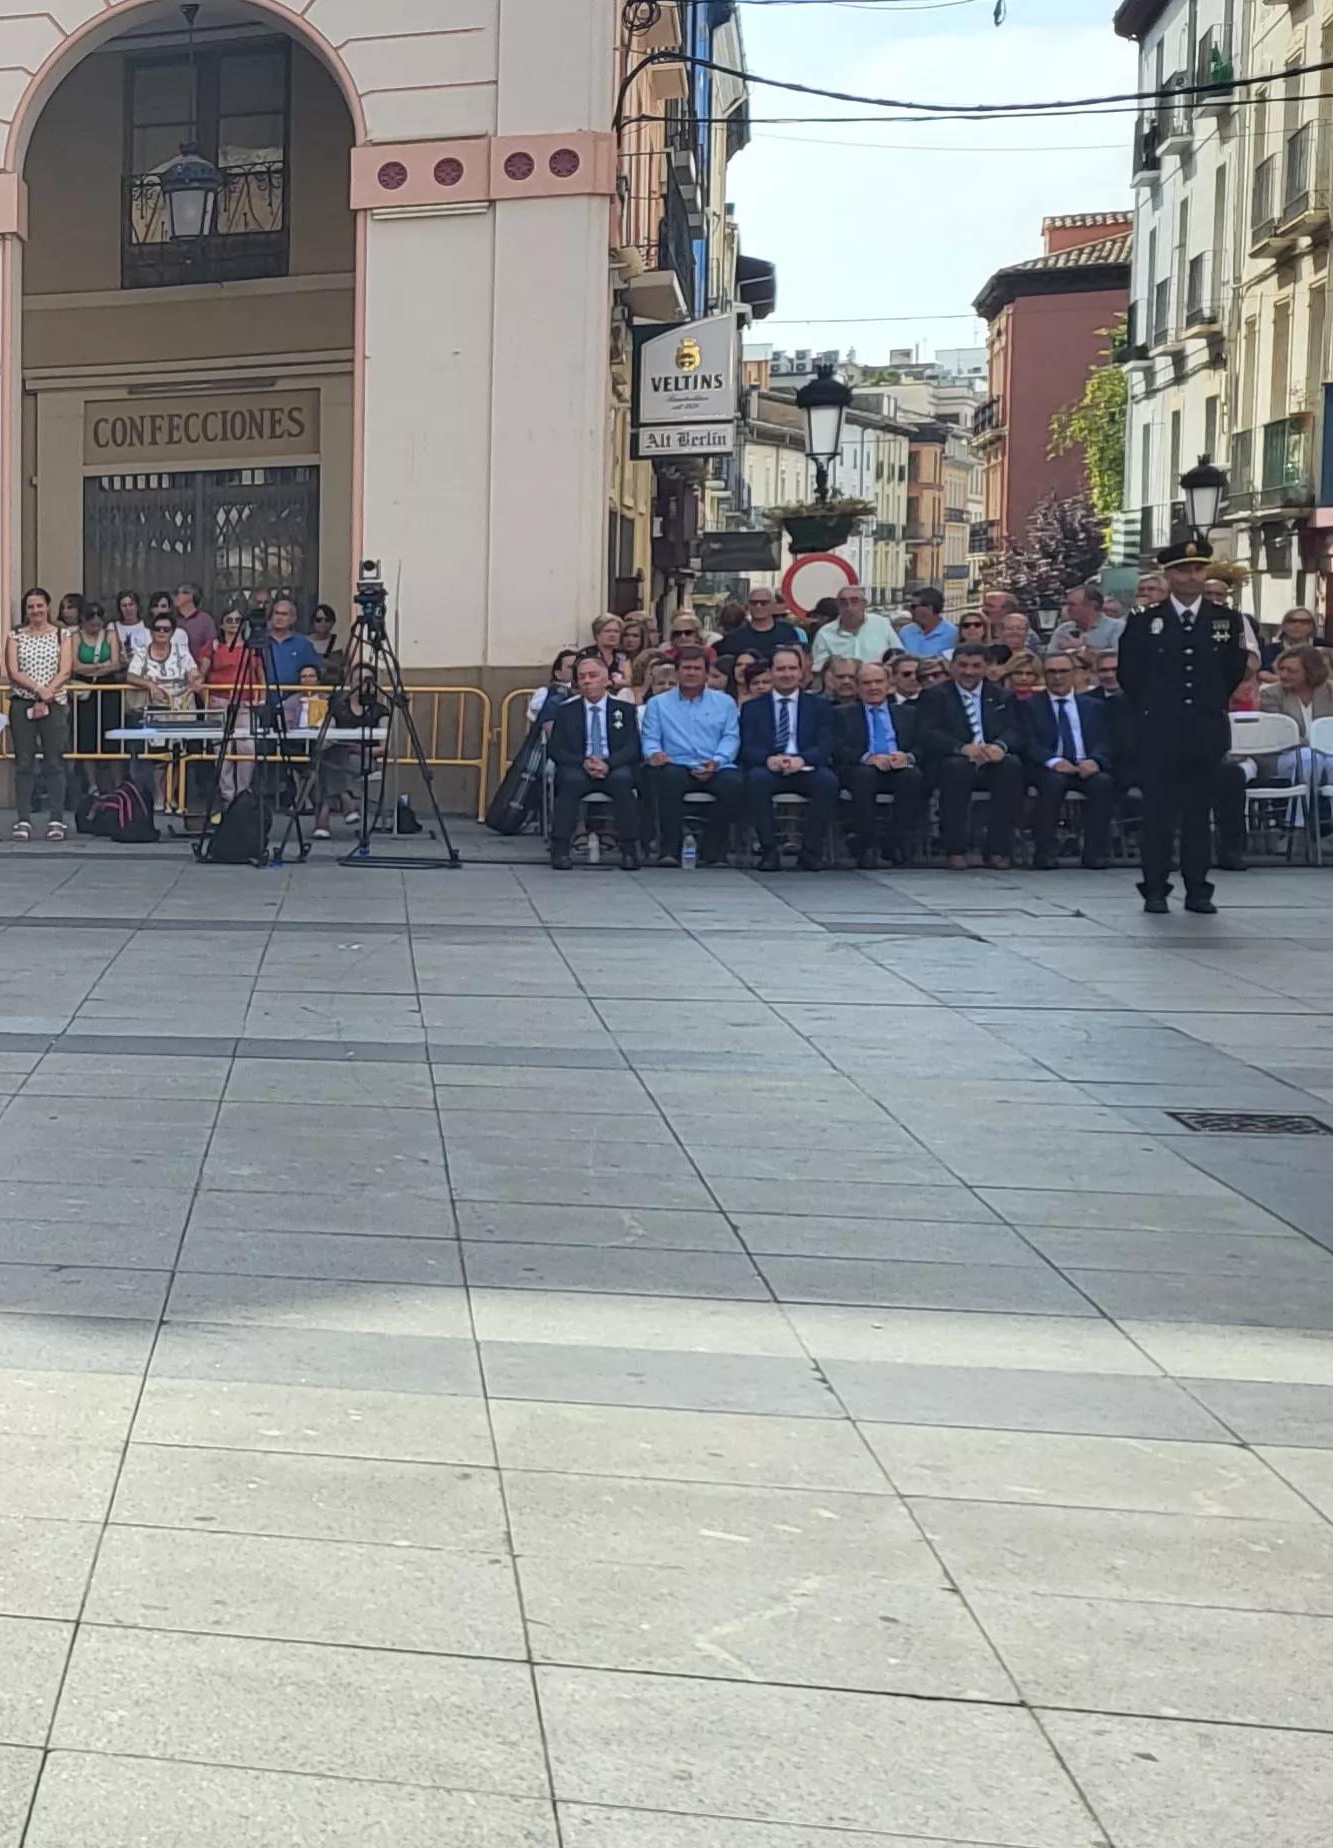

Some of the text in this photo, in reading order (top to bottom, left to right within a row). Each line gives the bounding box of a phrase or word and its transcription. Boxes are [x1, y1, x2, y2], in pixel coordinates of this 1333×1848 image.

[650, 373, 723, 392] VELTINS
[93, 406, 306, 448] CONFECCIONES
[644, 431, 727, 449] Alt Berlin
